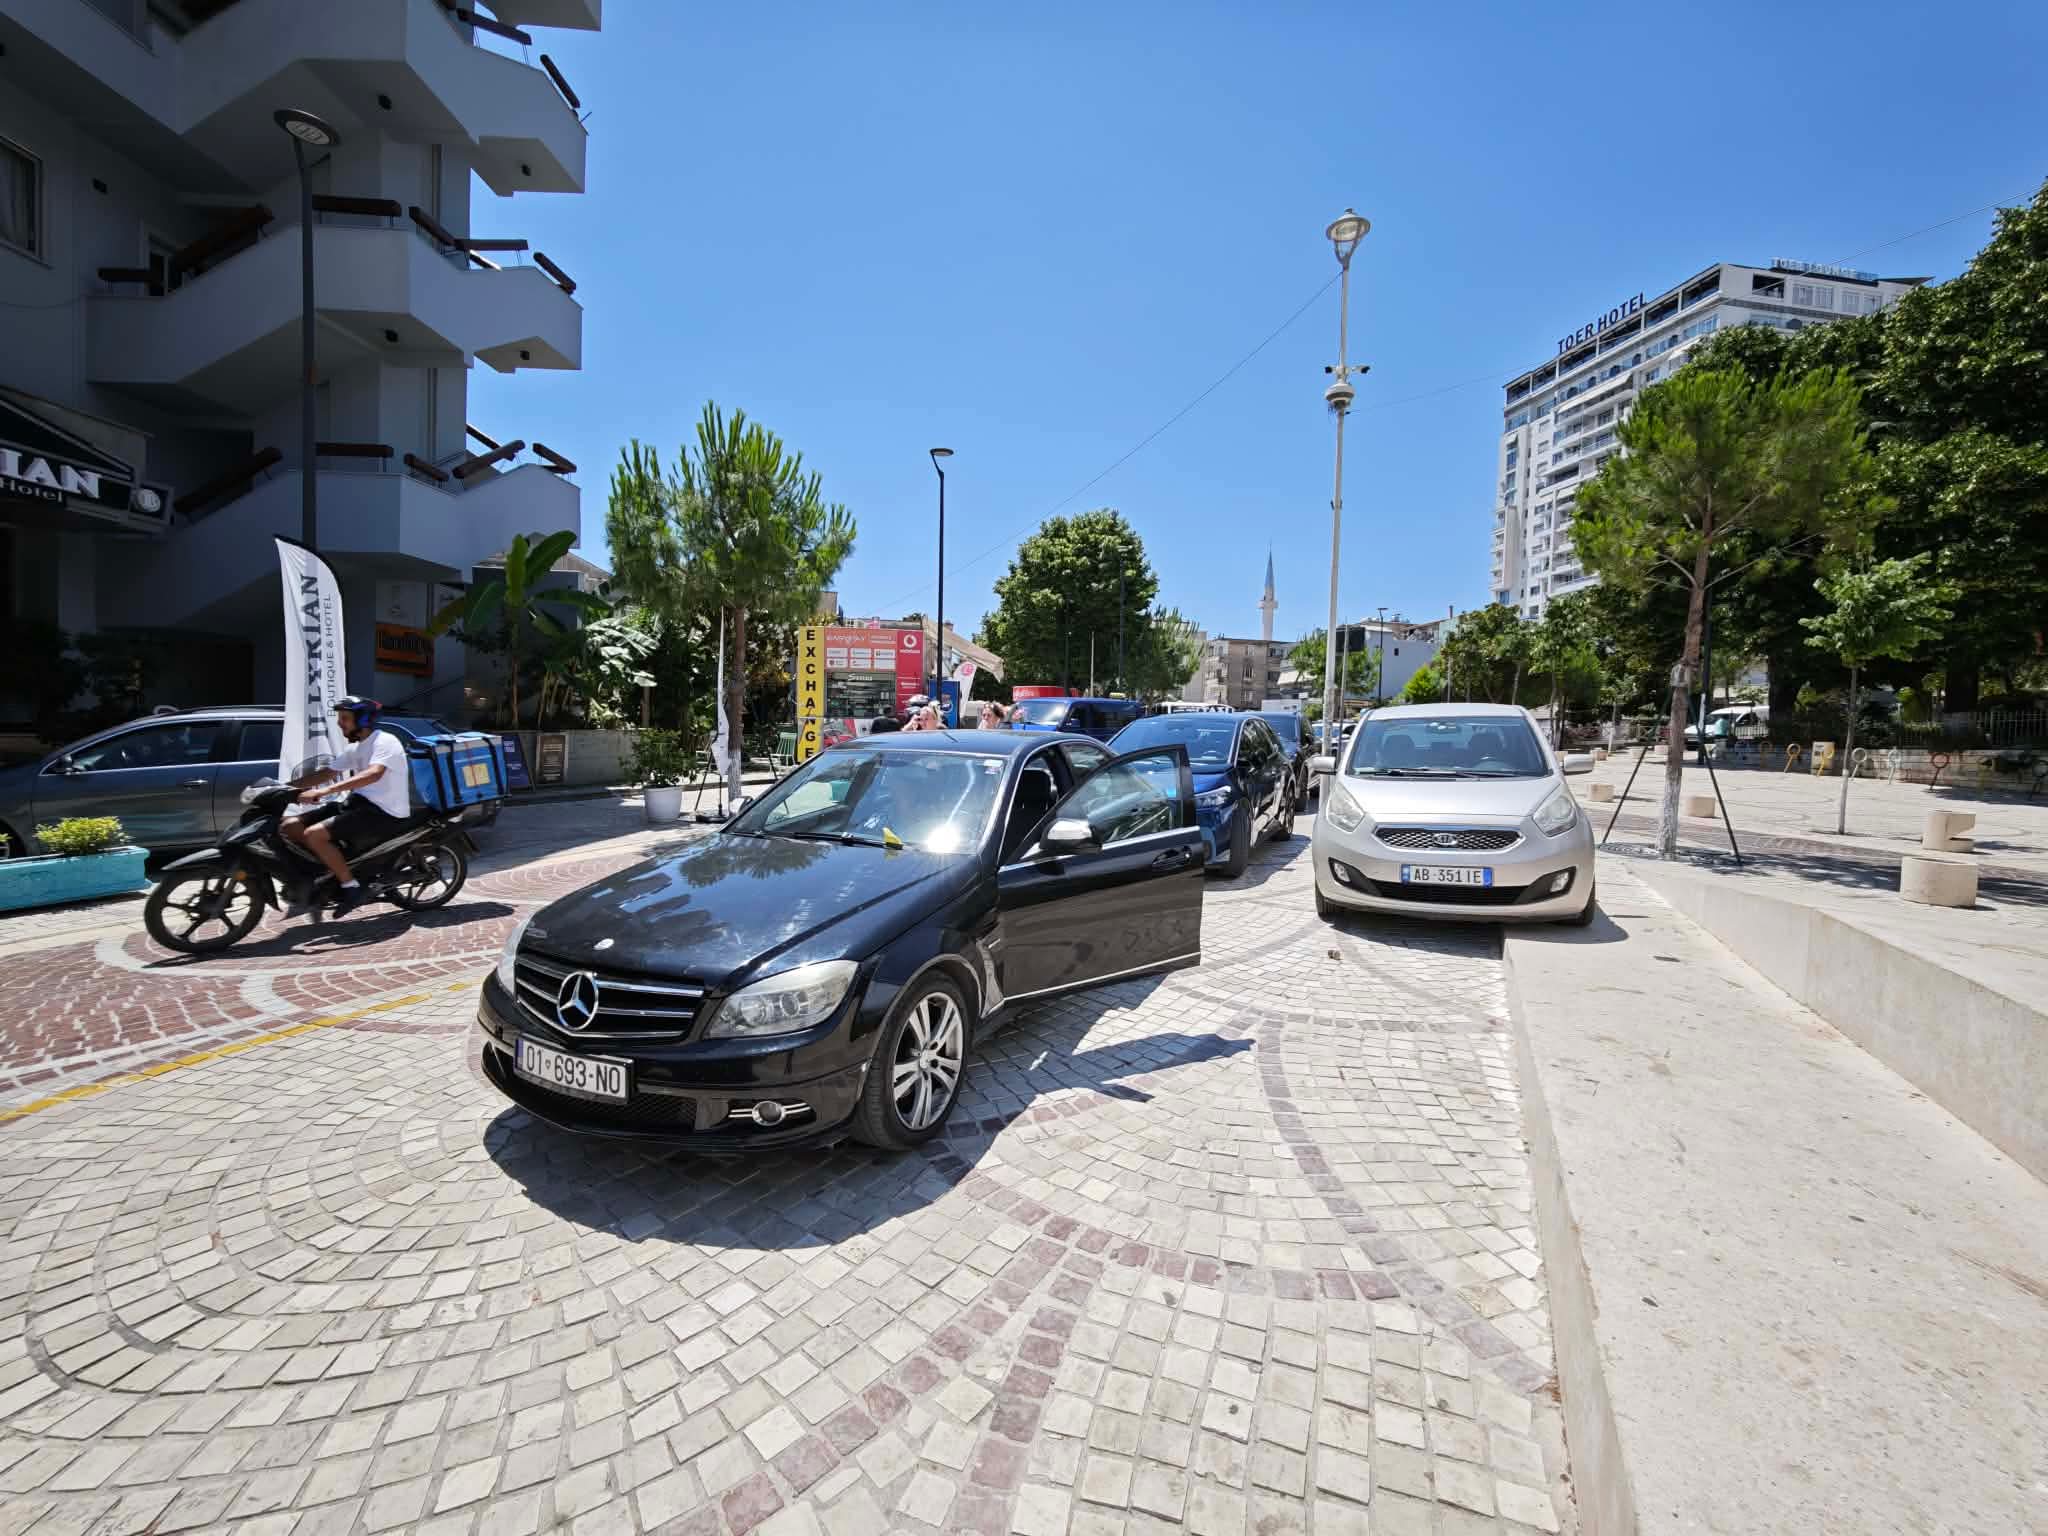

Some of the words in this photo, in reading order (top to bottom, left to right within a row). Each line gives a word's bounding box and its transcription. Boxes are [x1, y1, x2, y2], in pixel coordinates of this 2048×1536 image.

[1557, 322, 1594, 355] TOER
[1597, 291, 1647, 333] HOTEL
[323, 592, 335, 634] HOTEL
[325, 639, 334, 649] &
[301, 575, 328, 739] ILLYRIAN
[325, 651, 337, 717] BOUTIQUE
[805, 629, 816, 758] EXCHANGE
